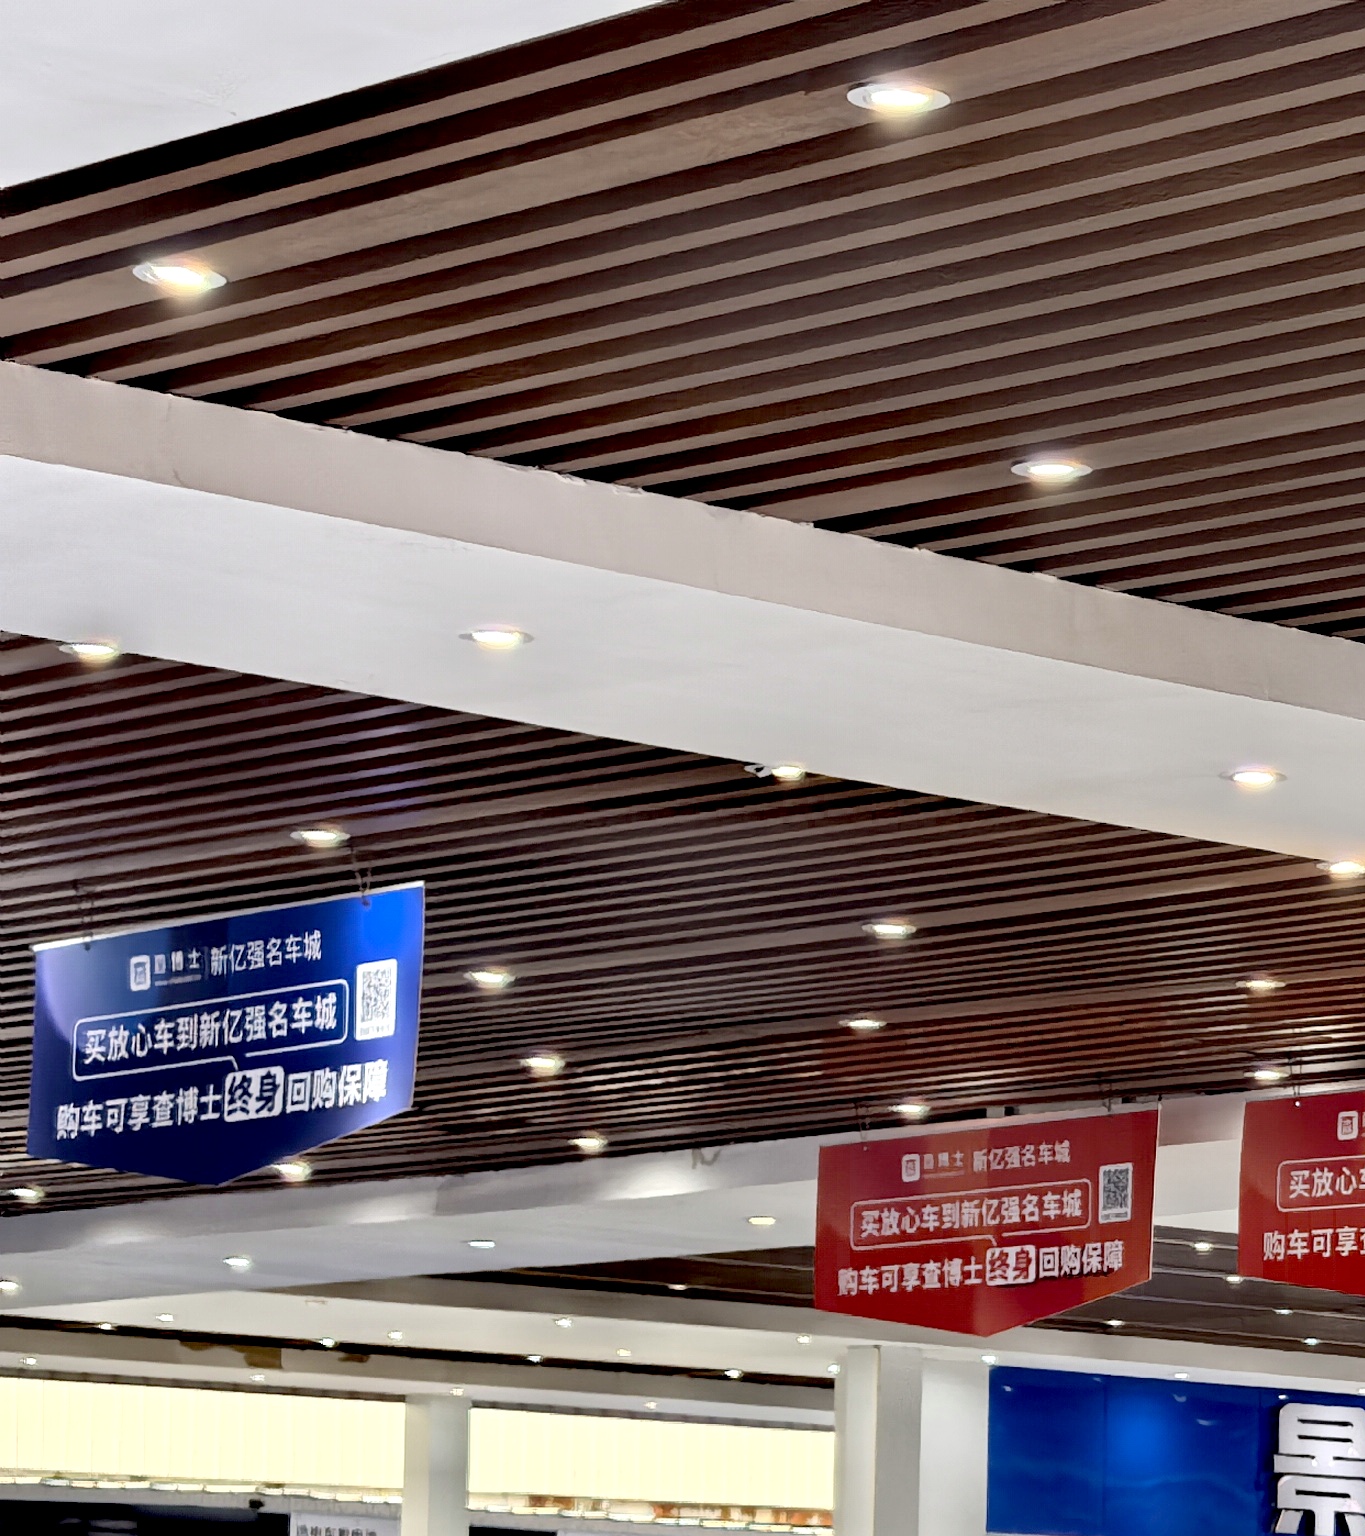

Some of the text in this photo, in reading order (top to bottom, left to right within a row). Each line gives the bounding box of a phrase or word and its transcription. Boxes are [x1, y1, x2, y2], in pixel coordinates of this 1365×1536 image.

[210, 930, 322, 976] 新亿强名车城
[84, 995, 338, 1066] 买放心车到新亿强名车城
[56, 1059, 389, 1140] 购车可享查博士终身回购保障
[973, 1140, 1071, 1173] 新亿强名车城
[860, 1189, 1083, 1239] 买放心车到新亿强名车城
[838, 1239, 1124, 1297] 购车可享查博士终身回购保障
